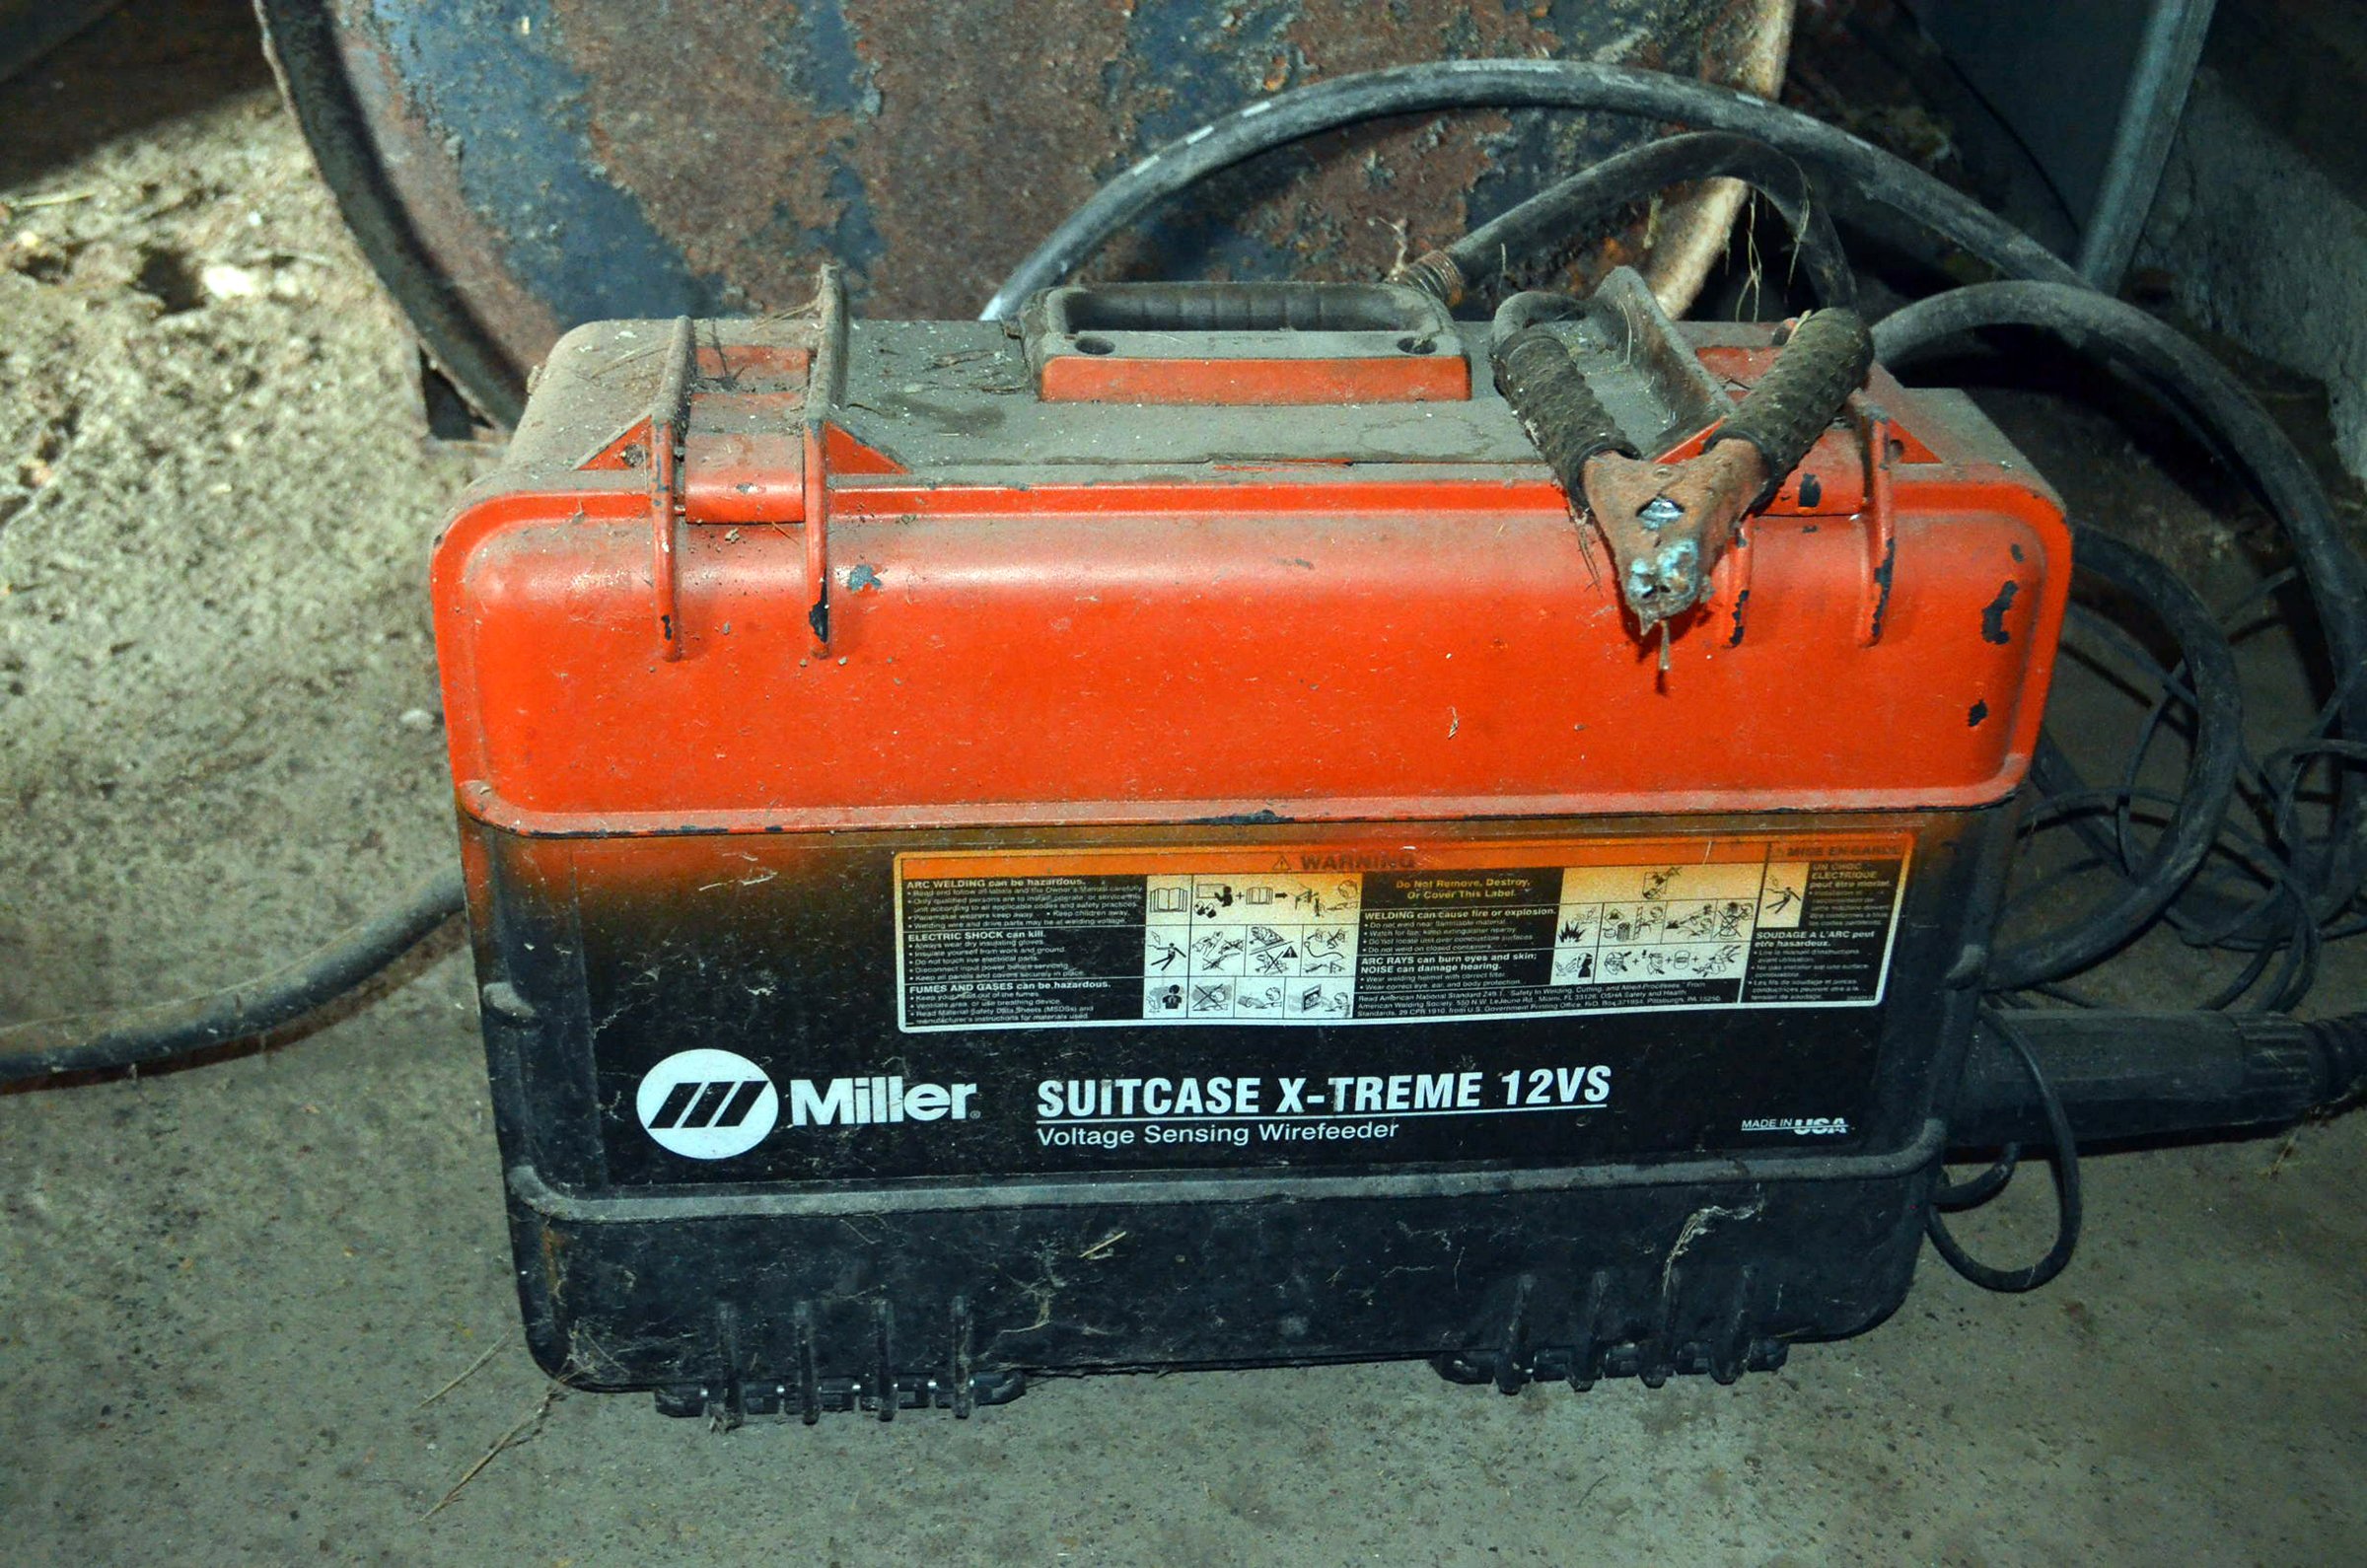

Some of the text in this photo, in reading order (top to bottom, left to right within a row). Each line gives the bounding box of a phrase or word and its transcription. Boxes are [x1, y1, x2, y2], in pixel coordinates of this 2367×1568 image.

[1829, 846, 1846, 856] EN
[906, 881, 930, 890] ARC
[933, 880, 985, 889] WELDING
[1027, 878, 1086, 887] hazardous.
[1436, 879, 1483, 889] Remove,
[1485, 878, 1531, 888] Destroy,
[1406, 891, 1420, 900] Or
[1364, 911, 1415, 920] WELDING
[1504, 907, 1557, 917] explosion.
[907, 932, 962, 942] ELECTRIC
[965, 931, 1003, 940] SHOCK
[1361, 965, 1394, 974] NOISE
[1417, 963, 1458, 973] damage
[1460, 962, 1502, 972] hearing.
[909, 985, 948, 994] FUMES
[976, 983, 1014, 992] GASES
[1038, 981, 1051, 990] be
[1054, 980, 1112, 989] hazardous.
[1037, 1065, 1612, 1117] SUITCASE X-TREME 12VS
[1741, 1117, 1847, 1135] MADE IN USA
[1037, 1121, 1399, 1149] Voltage Sensing Wirefeeder
